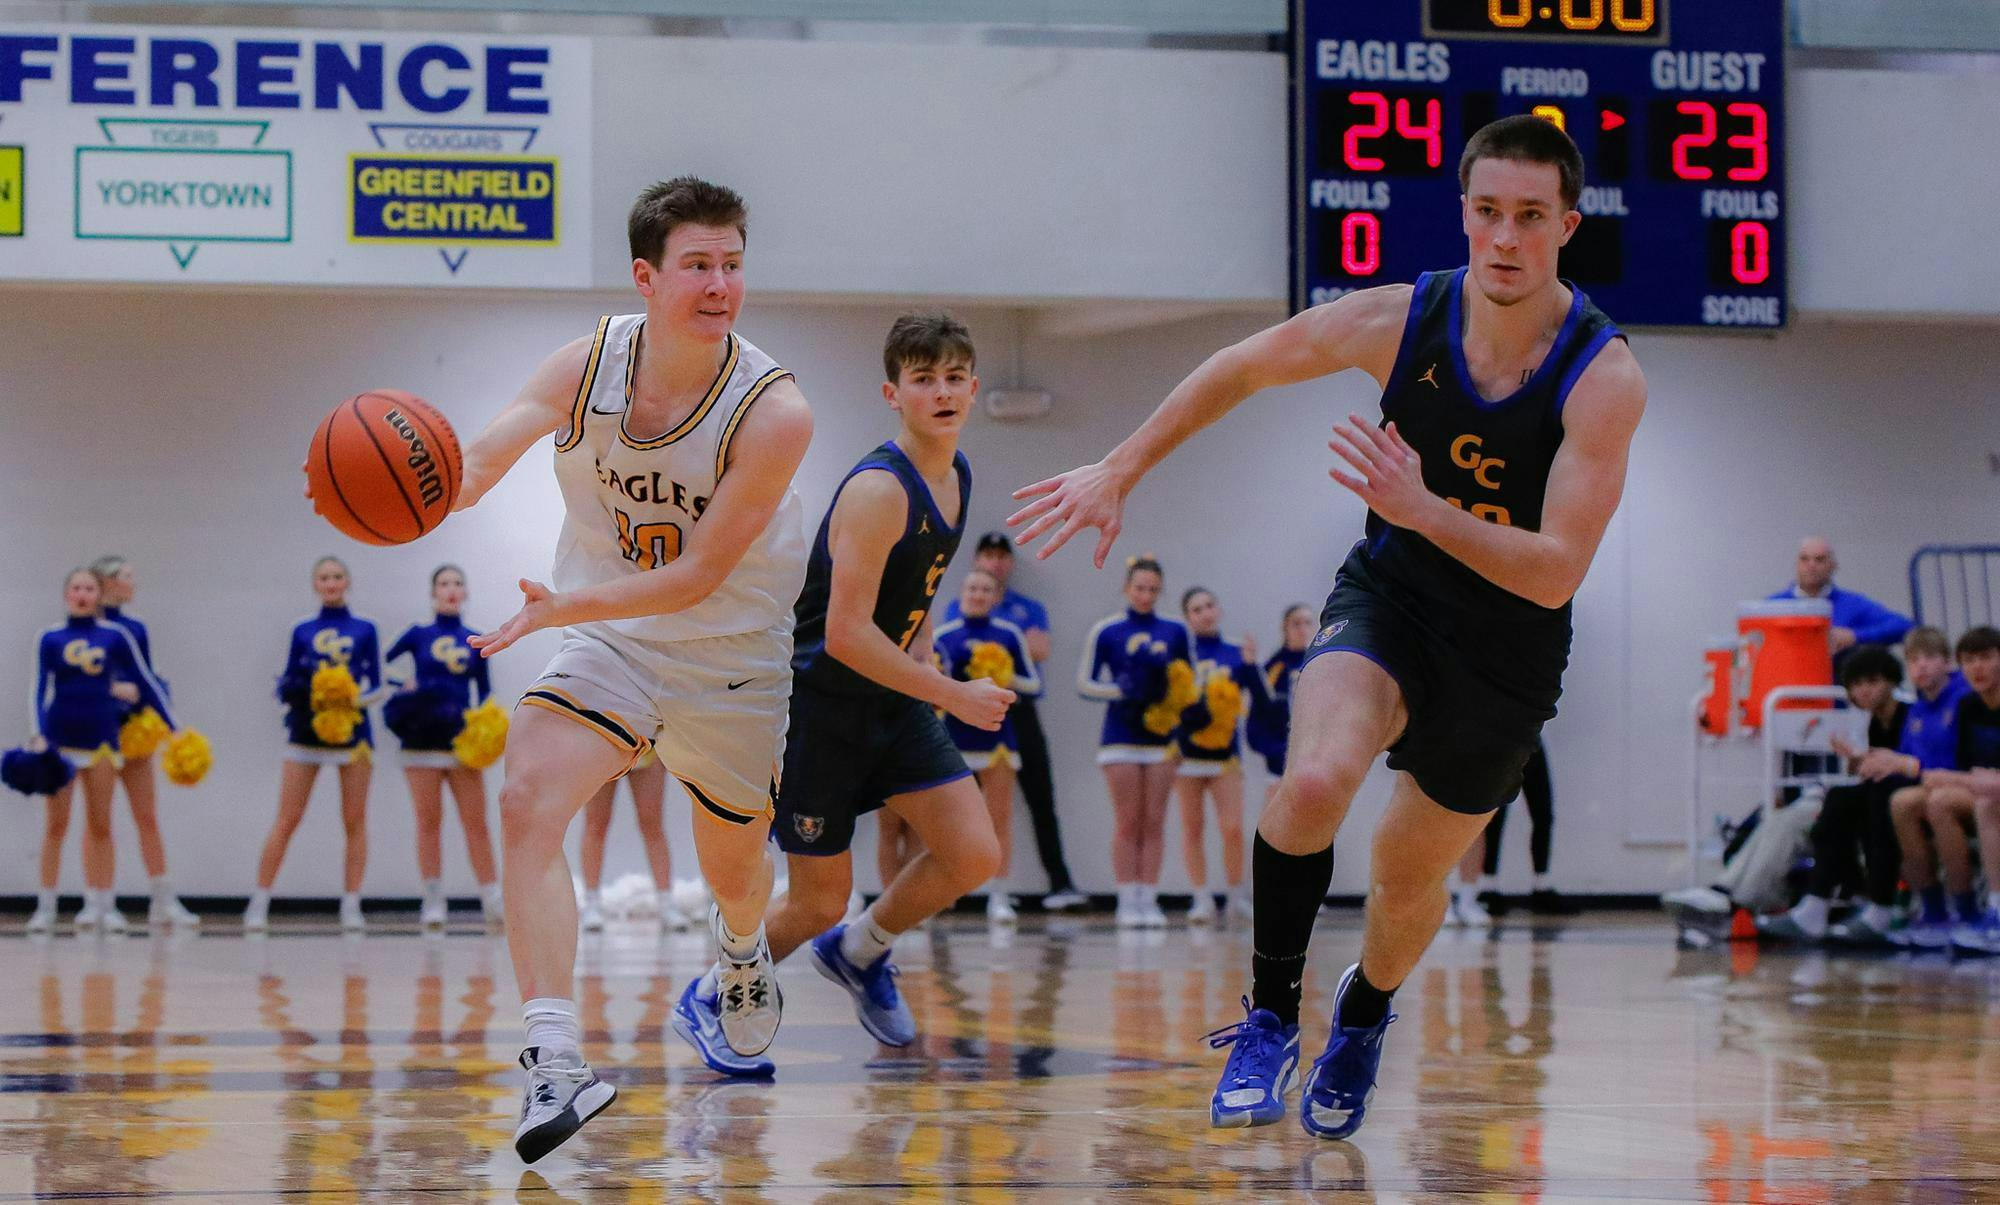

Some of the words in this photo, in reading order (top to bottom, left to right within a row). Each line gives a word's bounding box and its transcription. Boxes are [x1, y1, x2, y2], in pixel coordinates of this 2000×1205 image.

[1316, 38, 1450, 83] EAGLES
[1651, 49, 1765, 92] GUEST
[1502, 66, 1588, 97] PERIOD
[150, 126, 219, 146] TIGERS
[404, 131, 503, 151] COUGARS
[1343, 91, 1441, 172] 24
[1672, 101, 1768, 182] 23
[97, 180, 272, 209] YORKTOWN
[358, 167, 550, 199] GREENFIELD
[1310, 178, 1391, 210] FOULS
[381, 201, 527, 232] CENTRAL
[1702, 189, 1778, 220] FOULS
[1341, 212, 1380, 276] 0
[1730, 222, 1769, 285] 0
[1702, 295, 1779, 325] SCORE
[384, 408, 444, 510] Wilson
[1450, 434, 1505, 490] GC
[595, 457, 708, 522] EAGLES
[64, 637, 105, 676] GC
[430, 635, 471, 675] GC
